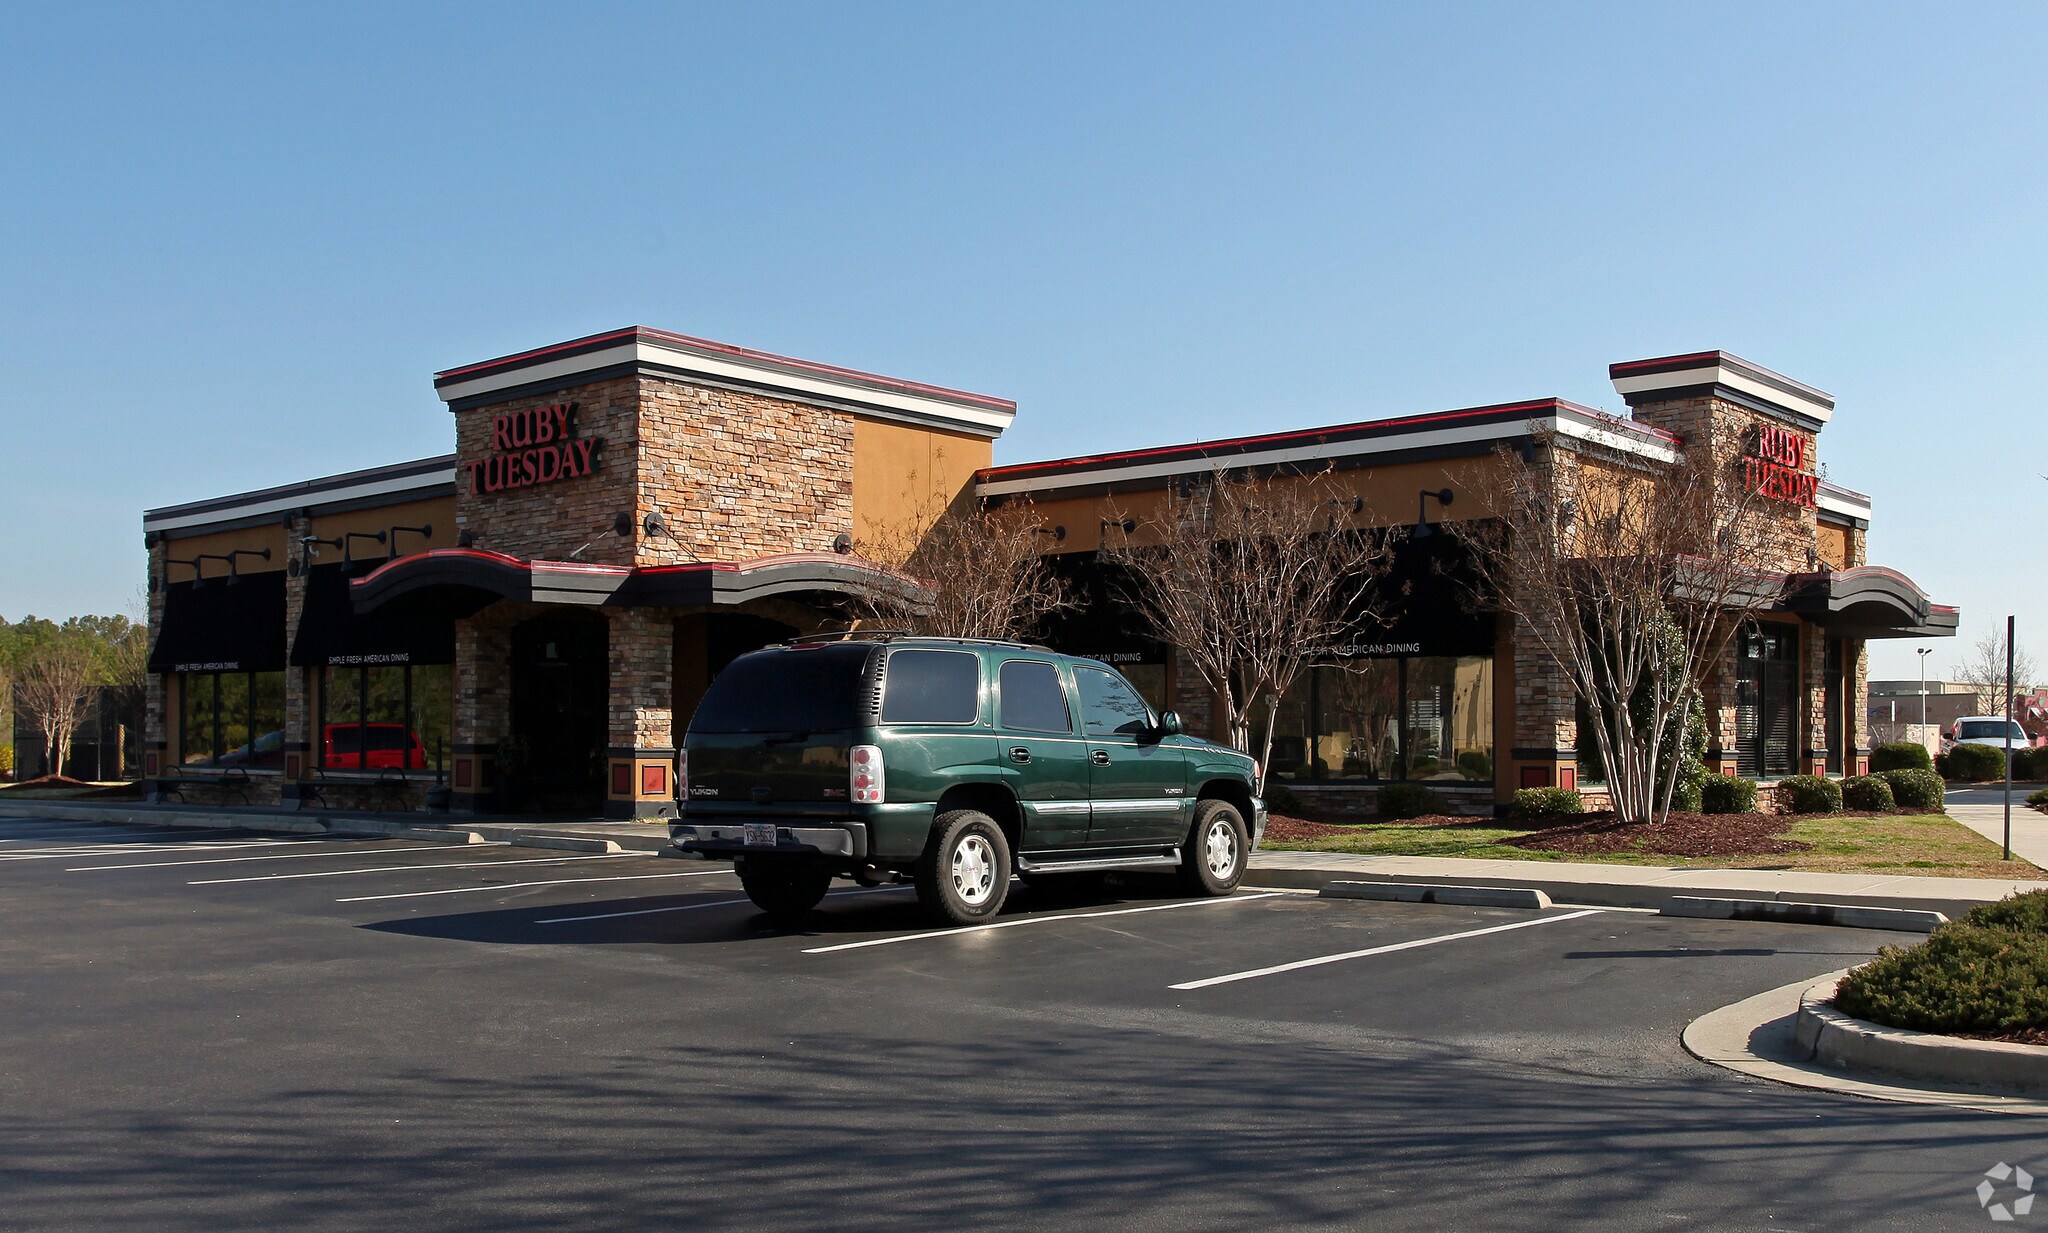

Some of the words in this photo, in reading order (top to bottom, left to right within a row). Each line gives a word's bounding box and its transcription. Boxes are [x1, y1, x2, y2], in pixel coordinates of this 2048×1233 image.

[493, 402, 574, 451] RUBY
[1759, 423, 1808, 471] RUBY
[464, 437, 597, 496] TUESDAY
[1742, 455, 1820, 509] TUESDAY
[346, 655, 362, 664] FRESH
[363, 654, 390, 663] AMERICAN
[390, 652, 409, 662] DINING
[1113, 652, 1142, 662] DINING
[1386, 642, 1420, 654] DINING
[689, 788, 719, 796] YUKON
